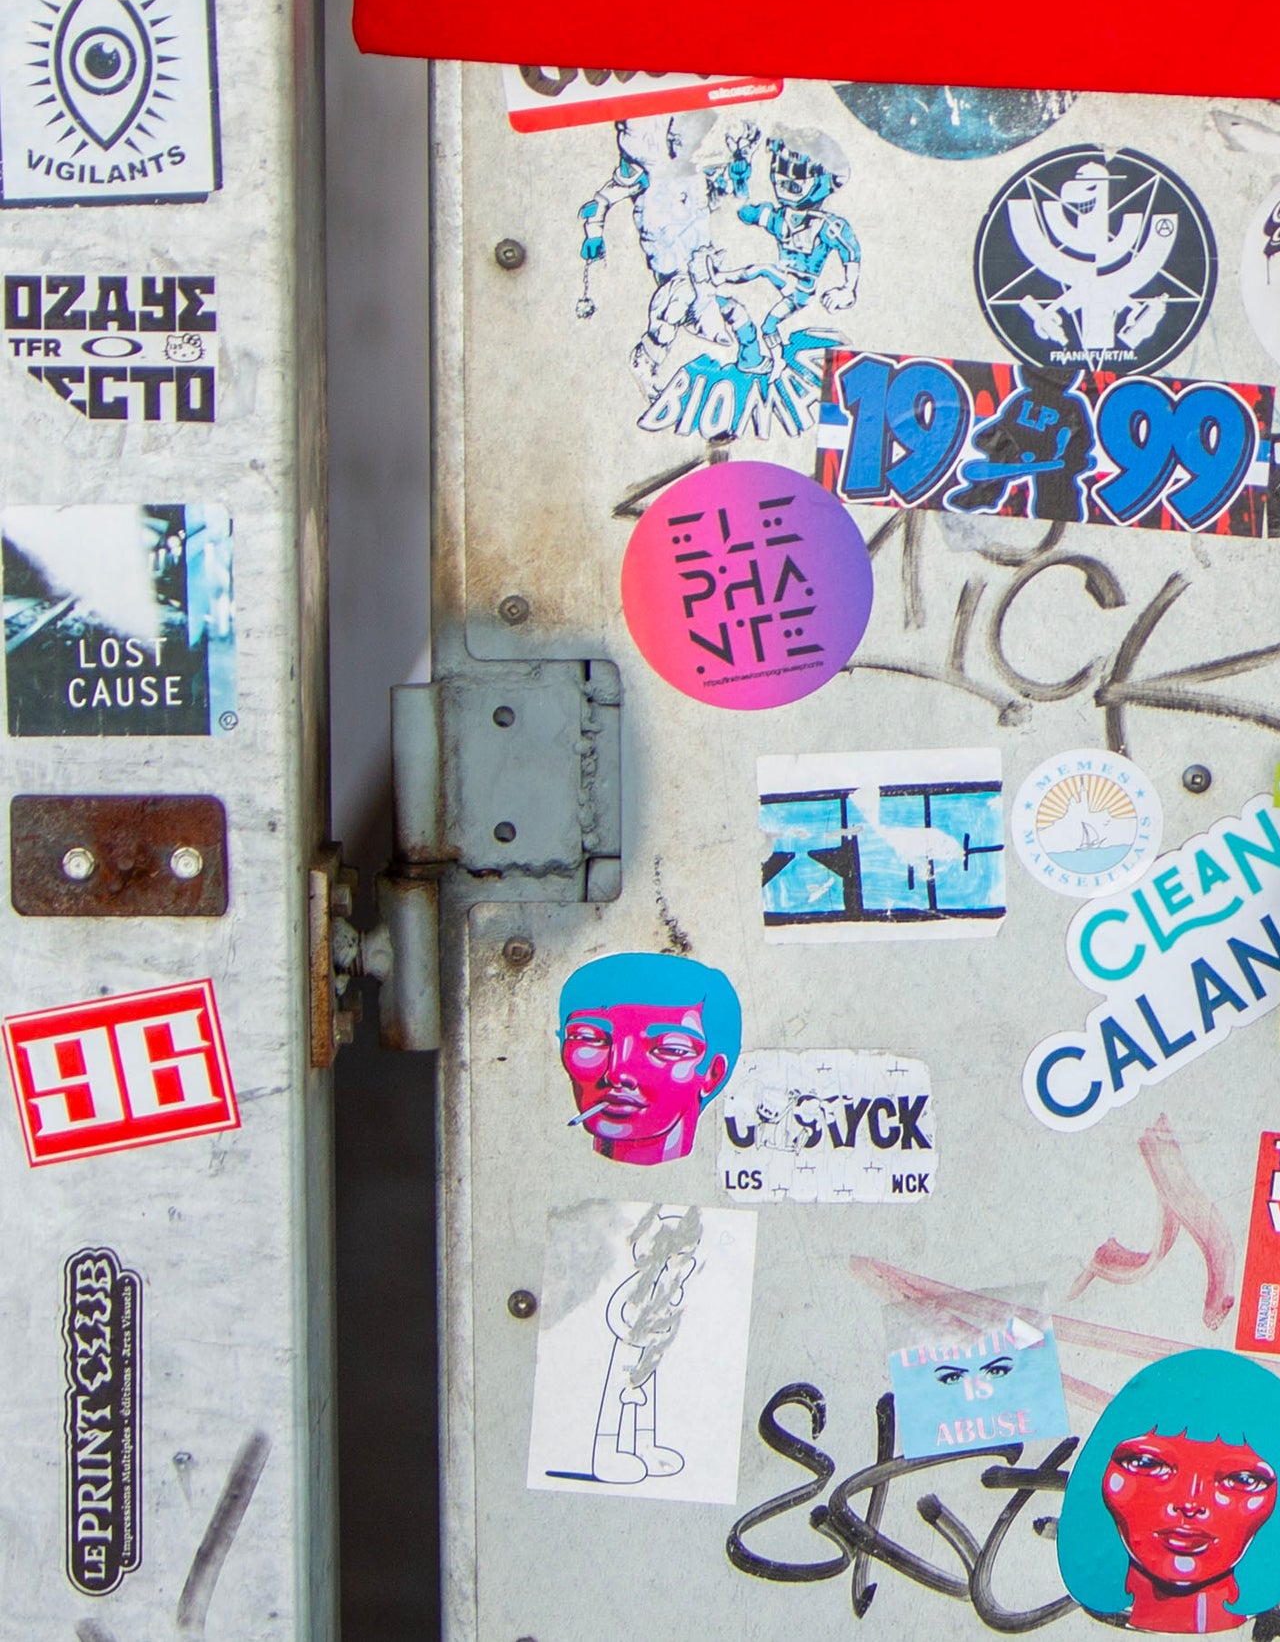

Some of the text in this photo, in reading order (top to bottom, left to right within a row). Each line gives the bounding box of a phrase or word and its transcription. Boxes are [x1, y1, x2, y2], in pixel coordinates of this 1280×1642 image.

[26, 144, 187, 184] VIGILANTS
[8, 338, 62, 358] TFR
[27, 365, 216, 423] ECTO
[1015, 399, 1060, 432] LP
[836, 354, 1260, 532] 19 99
[79, 637, 168, 669] LOST
[67, 675, 183, 708] CAUSE
[1034, 760, 1130, 791] MEMES
[1022, 815, 1150, 888] MARSEILLAIS
[725, 1170, 930, 1194] LCS WCK
[963, 1374, 994, 1402] IS
[936, 1408, 1038, 1447] ABUSE
[76, 1395, 113, 1543] PRINT
[122, 1427, 133, 1484] Multiples
[122, 1486, 133, 1557] Impressions
[84, 1545, 106, 1580] LE
